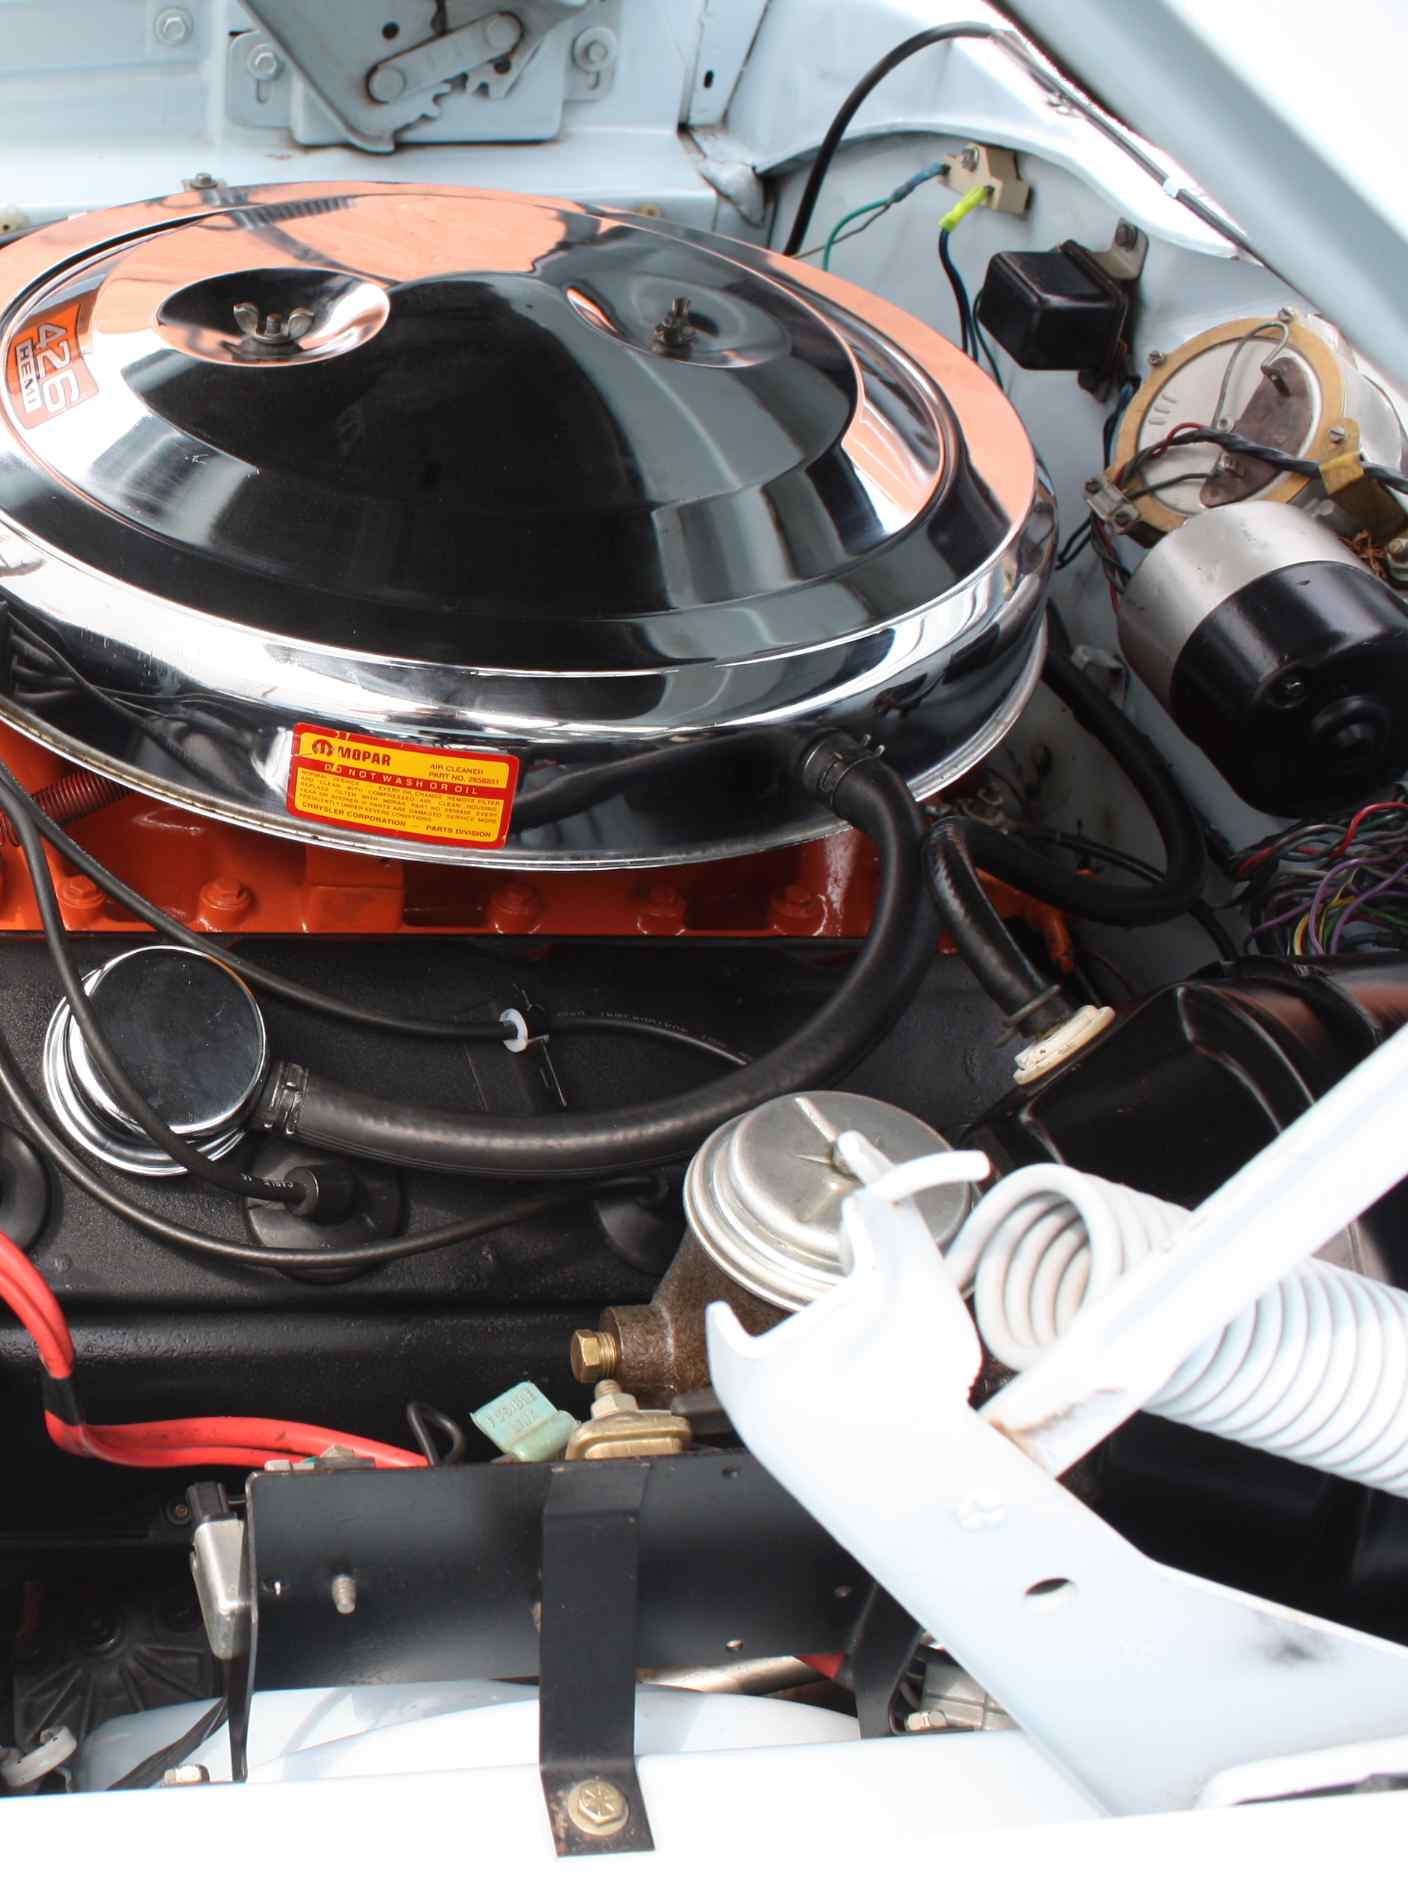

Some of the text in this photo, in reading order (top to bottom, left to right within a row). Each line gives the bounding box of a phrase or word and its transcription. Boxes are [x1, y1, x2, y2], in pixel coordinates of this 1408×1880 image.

[19, 345, 36, 405] HEMI
[35, 322, 81, 413] 426
[337, 745, 392, 767] MOPAR
[324, 763, 478, 795] DO NOT WASH OR OIL
[428, 771, 449, 779] PART
[430, 763, 484, 775] AIR CLEANER
[302, 801, 407, 827] CHRYSLER CORPORATION
[426, 825, 491, 838] PARTS DIVISION
